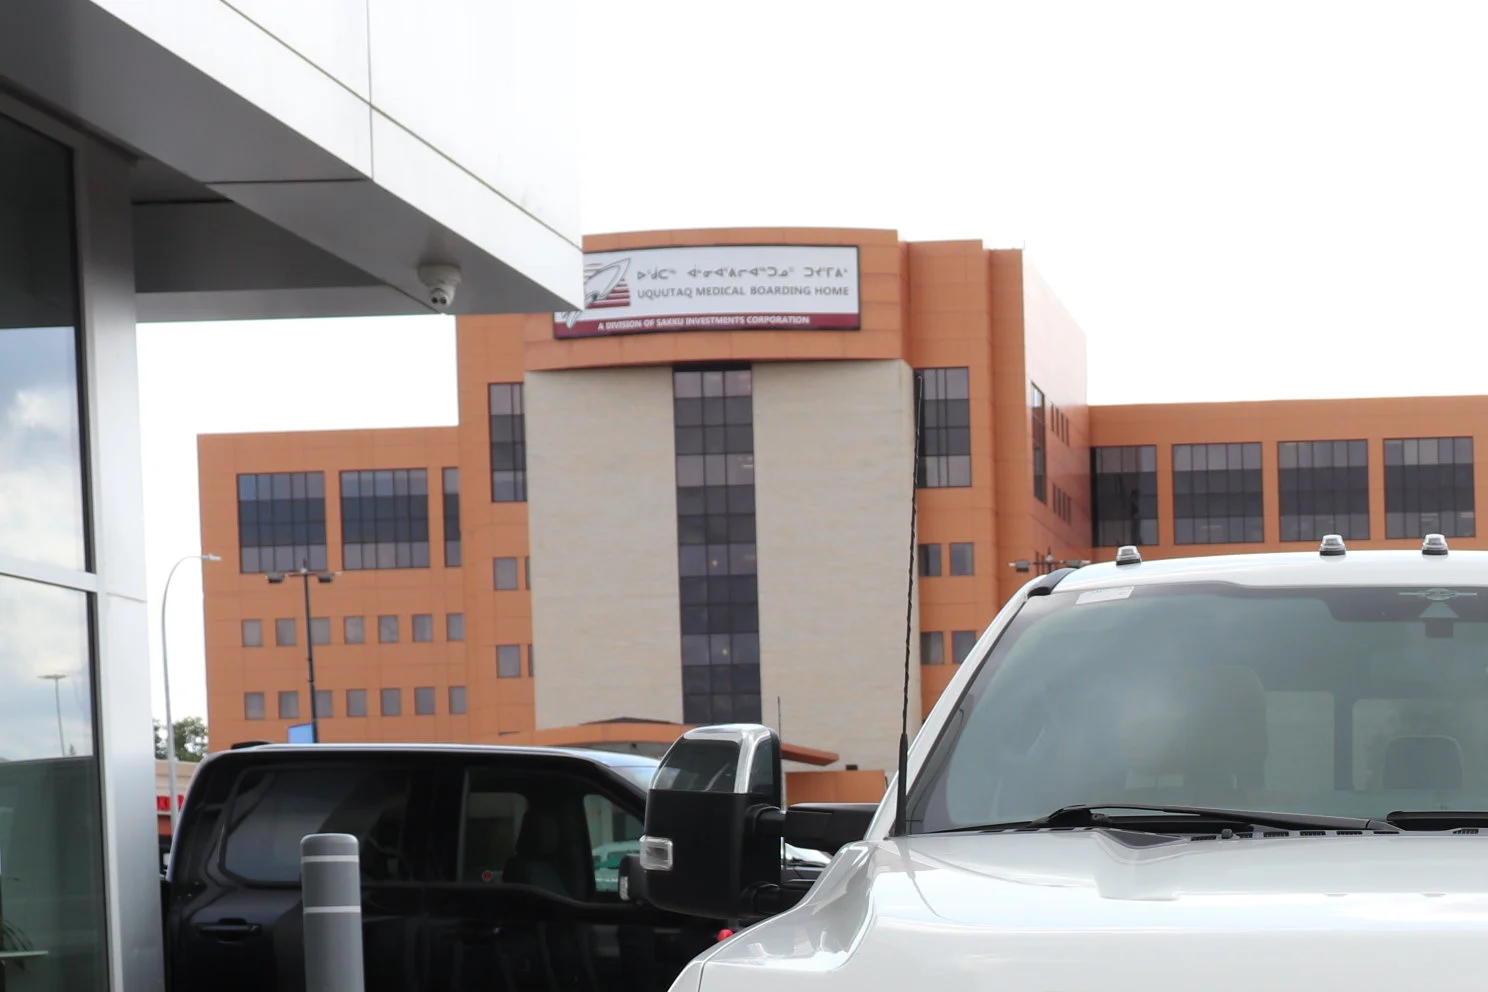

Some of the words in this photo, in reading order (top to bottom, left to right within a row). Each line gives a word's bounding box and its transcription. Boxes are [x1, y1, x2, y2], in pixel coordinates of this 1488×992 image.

[637, 287, 693, 300] UQUUTAQ
[695, 286, 745, 297] MEDICAL
[750, 285, 811, 296] BOARDING
[814, 286, 849, 296] HOME
[597, 323, 604, 331] A
[605, 321, 642, 330] DIVISION
[643, 319, 655, 328] OF
[656, 318, 684, 327] SAKKU
[685, 316, 745, 326] INVESTMENTS
[746, 315, 810, 325] CORPORATION
